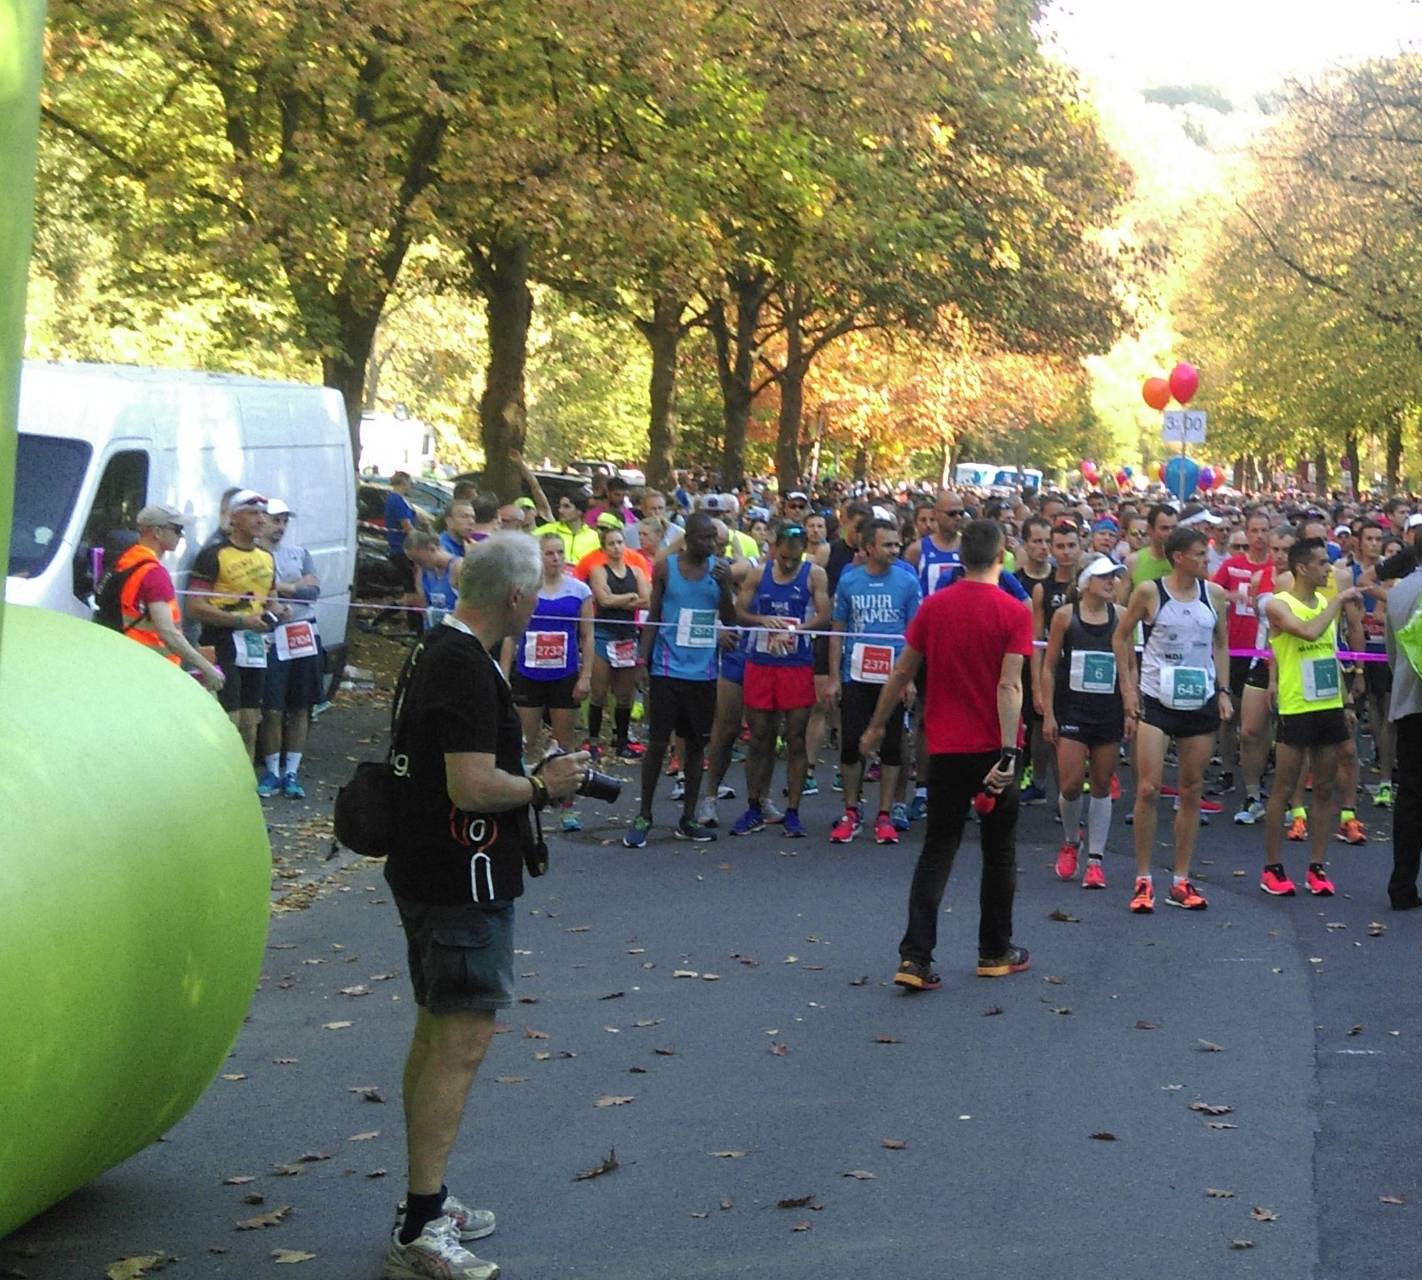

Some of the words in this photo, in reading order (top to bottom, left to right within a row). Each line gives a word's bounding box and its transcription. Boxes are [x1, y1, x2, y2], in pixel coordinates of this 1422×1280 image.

[851, 594, 892, 609] RUHR
[863, 659, 889, 670] 2371
[1095, 668, 1104, 679] 6
[1177, 683, 1203, 696] 643
